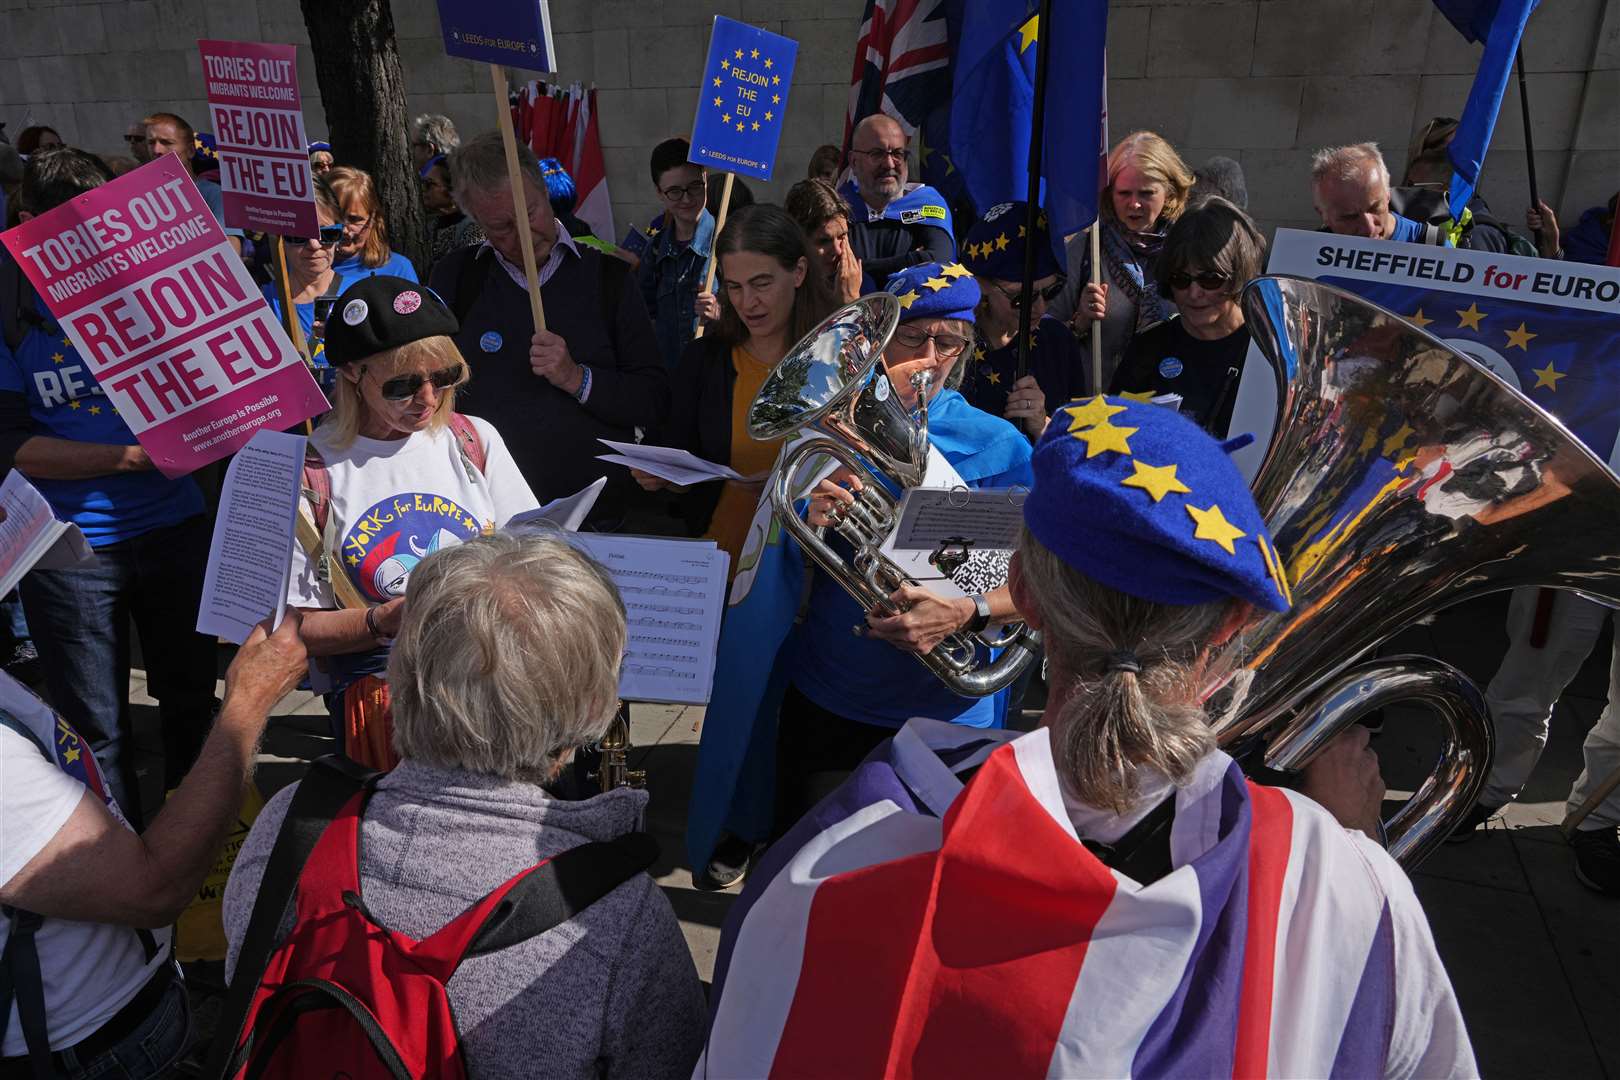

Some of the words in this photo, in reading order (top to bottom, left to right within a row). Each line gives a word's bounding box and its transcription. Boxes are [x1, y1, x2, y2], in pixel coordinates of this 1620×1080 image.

[462, 32, 483, 45] LEEDS
[497, 38, 526, 52] EUROPE
[204, 55, 256, 81] TORIES
[258, 58, 291, 84] OUT
[731, 67, 769, 88] REJOIN
[209, 81, 249, 98] MIGRANTS
[249, 85, 295, 102] WELCOME
[736, 104, 751, 117] EU
[737, 86, 758, 102] THE
[214, 107, 301, 150] REJOIN
[222, 155, 268, 194] THE
[271, 161, 307, 198] EU
[708, 150, 726, 161] LEEDS
[736, 156, 758, 168] EUROPE
[22, 207, 132, 280] TORIES
[127, 177, 193, 231] OUT
[46, 251, 130, 303] MIGRANTS
[125, 214, 212, 265] WELCOME
[1316, 246, 1475, 284] SHEFFIELD
[1483, 264, 1528, 290] for
[1531, 272, 1620, 303] EURO
[71, 252, 247, 366] REJOIN
[33, 365, 104, 408] RE
[111, 349, 219, 424] THE
[206, 317, 284, 386] EU
[182, 424, 212, 442] Another
[210, 412, 239, 431] Europe
[236, 409, 246, 418] is
[244, 394, 279, 414] Possible
[192, 408, 282, 453] www.anothereurope.org
[393, 499, 412, 518] for
